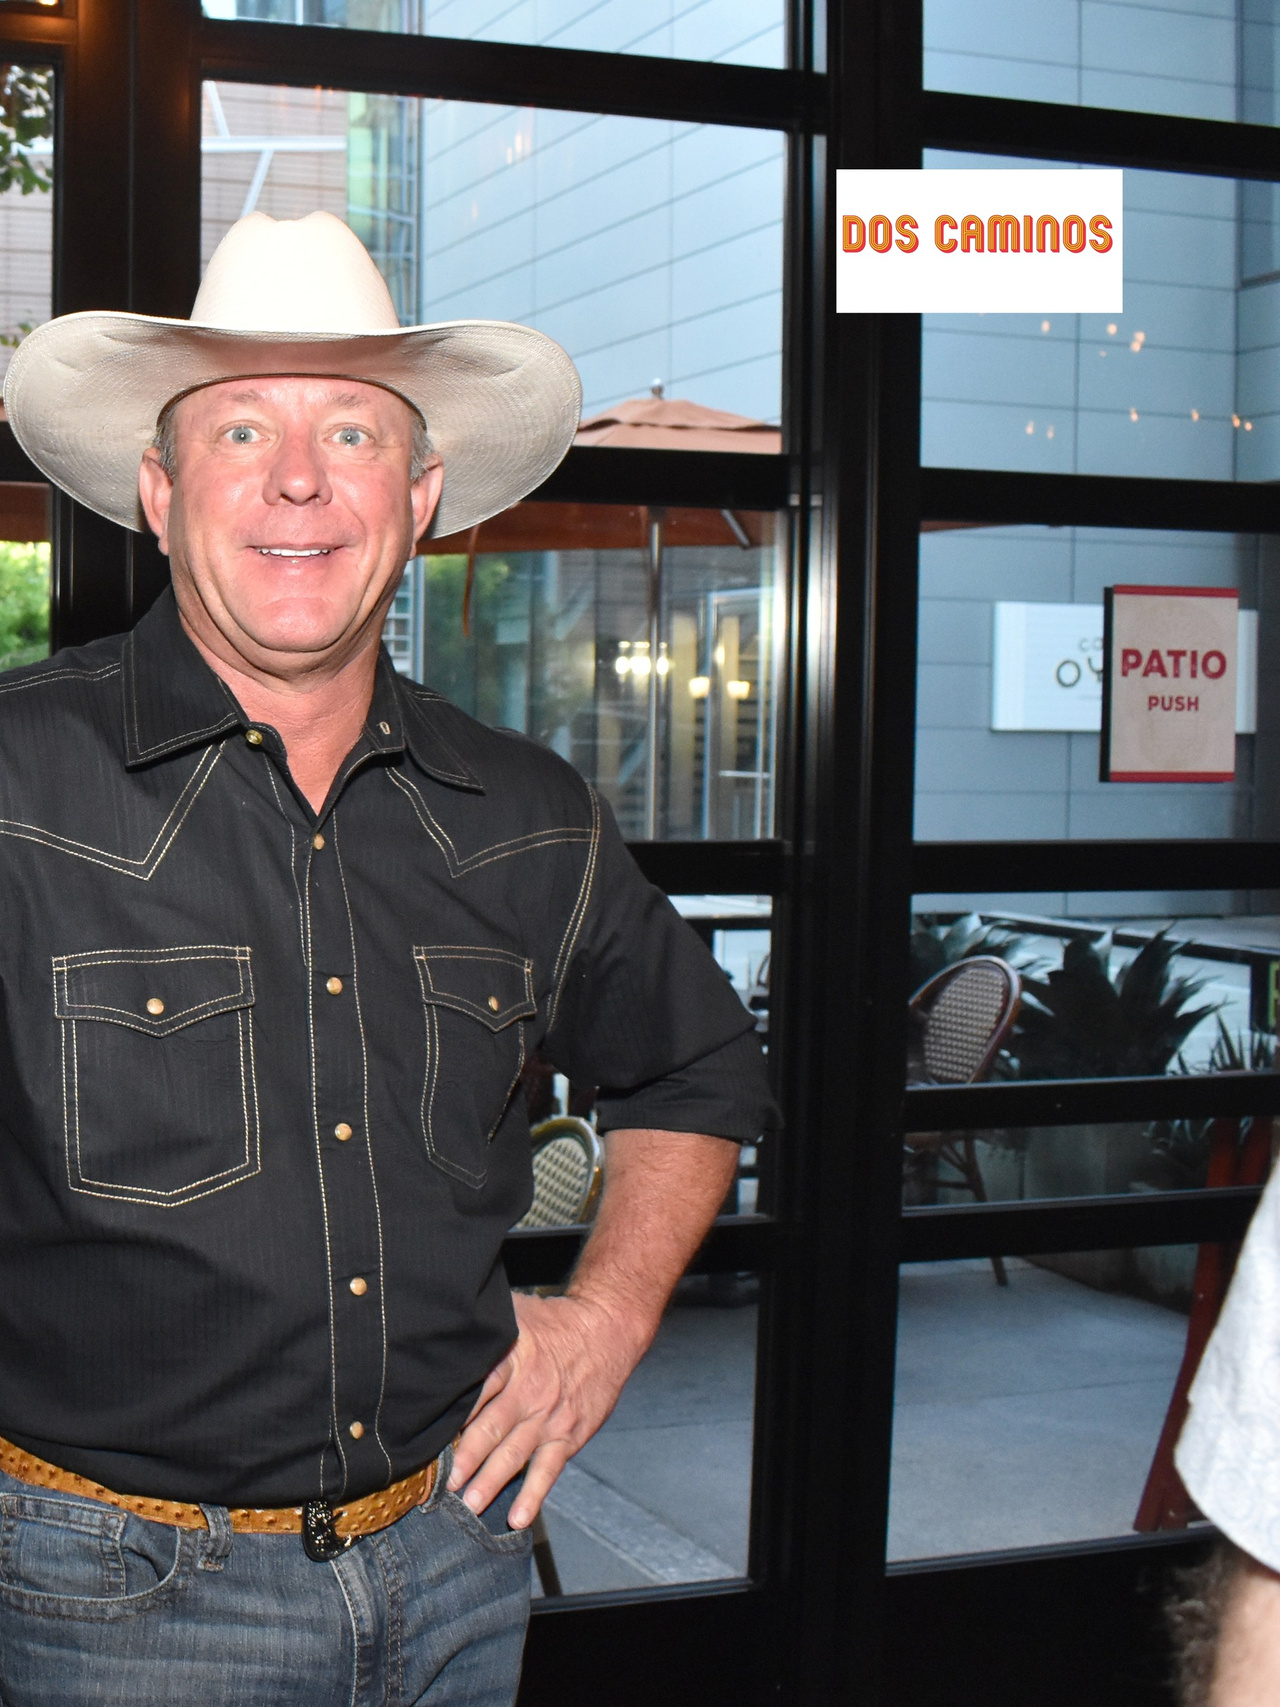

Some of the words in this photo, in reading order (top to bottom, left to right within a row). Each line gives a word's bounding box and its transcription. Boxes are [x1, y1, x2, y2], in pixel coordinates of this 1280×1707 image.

[1079, 637, 1104, 651] CO
[1055, 656, 1103, 688] OY
[1121, 648, 1227, 680] PATIO
[1147, 695, 1199, 712] PUSH
